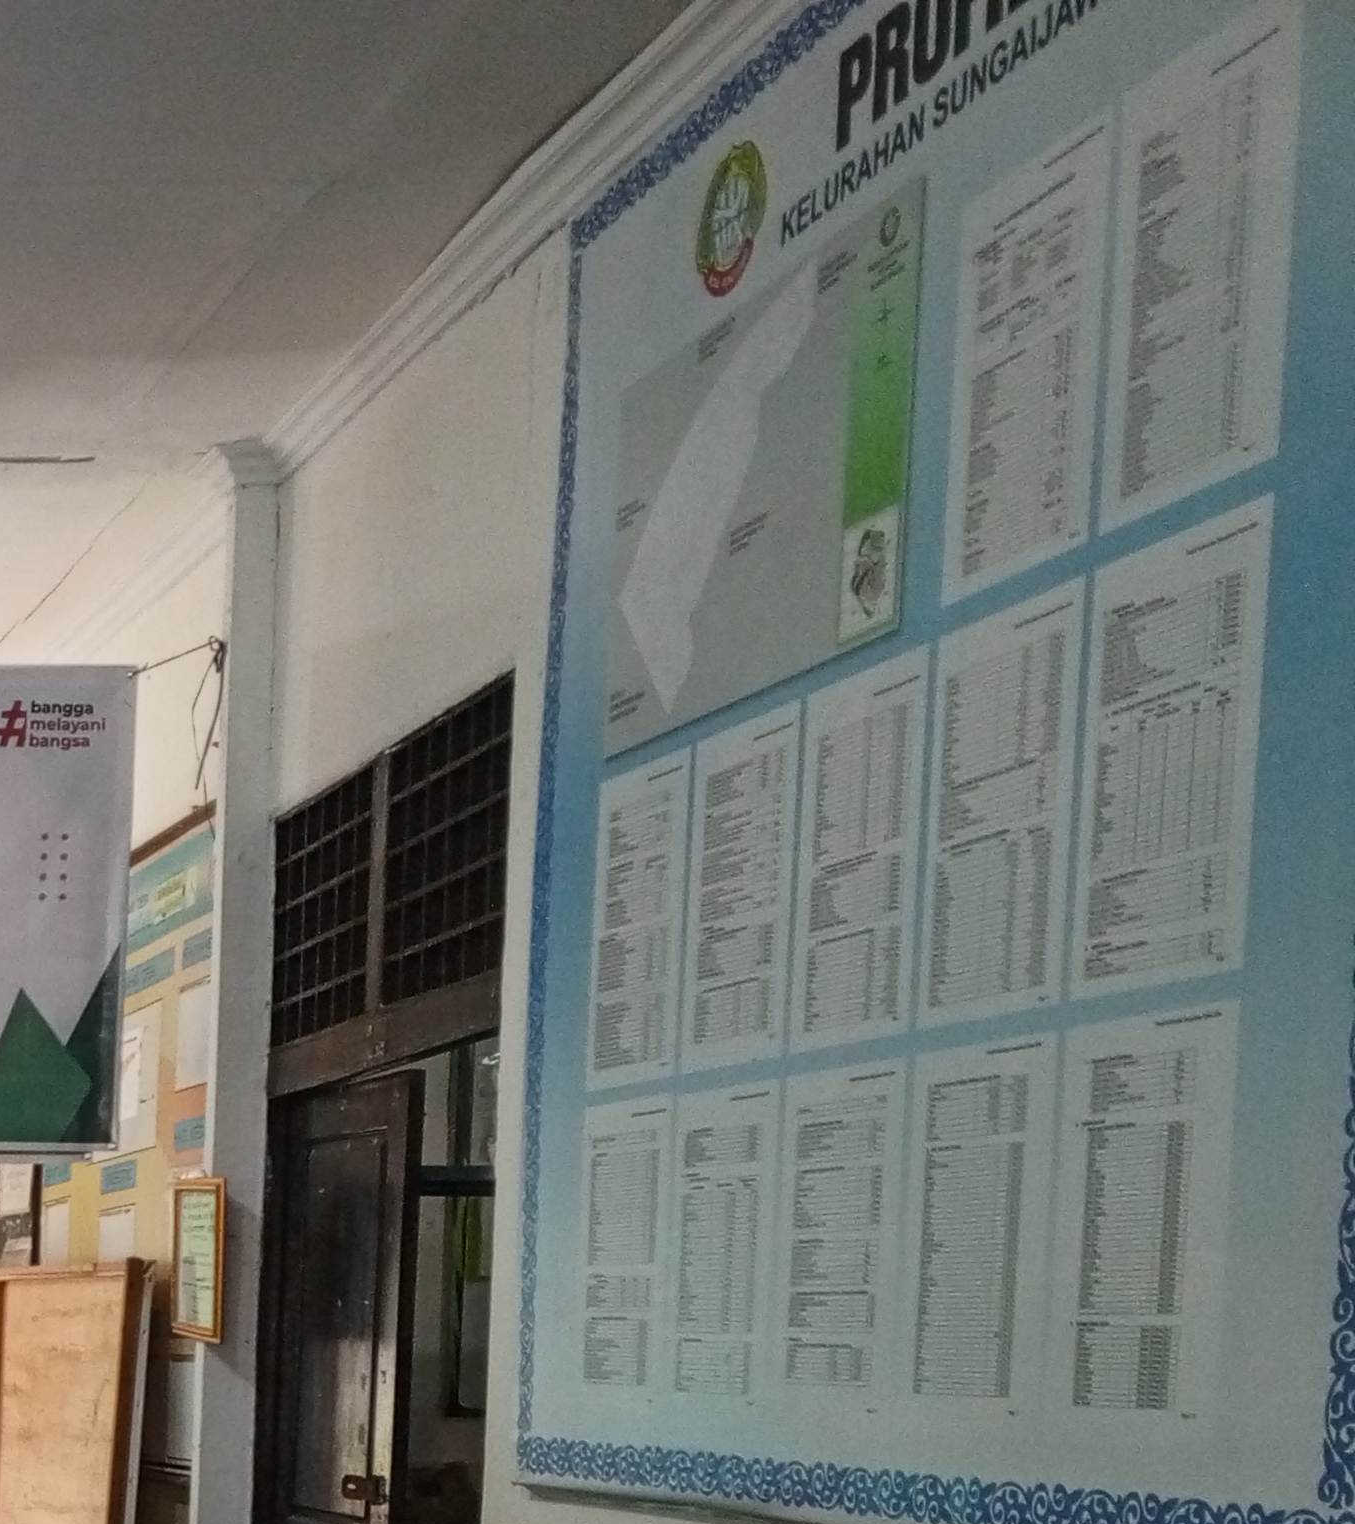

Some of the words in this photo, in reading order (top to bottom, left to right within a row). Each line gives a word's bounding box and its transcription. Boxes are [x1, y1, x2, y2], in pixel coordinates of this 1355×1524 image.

[780, 103, 926, 248] KELURAHAN
[30, 700, 95, 716] bangga
[29, 717, 106, 734] melayani
[29, 733, 90, 750] bangsa
